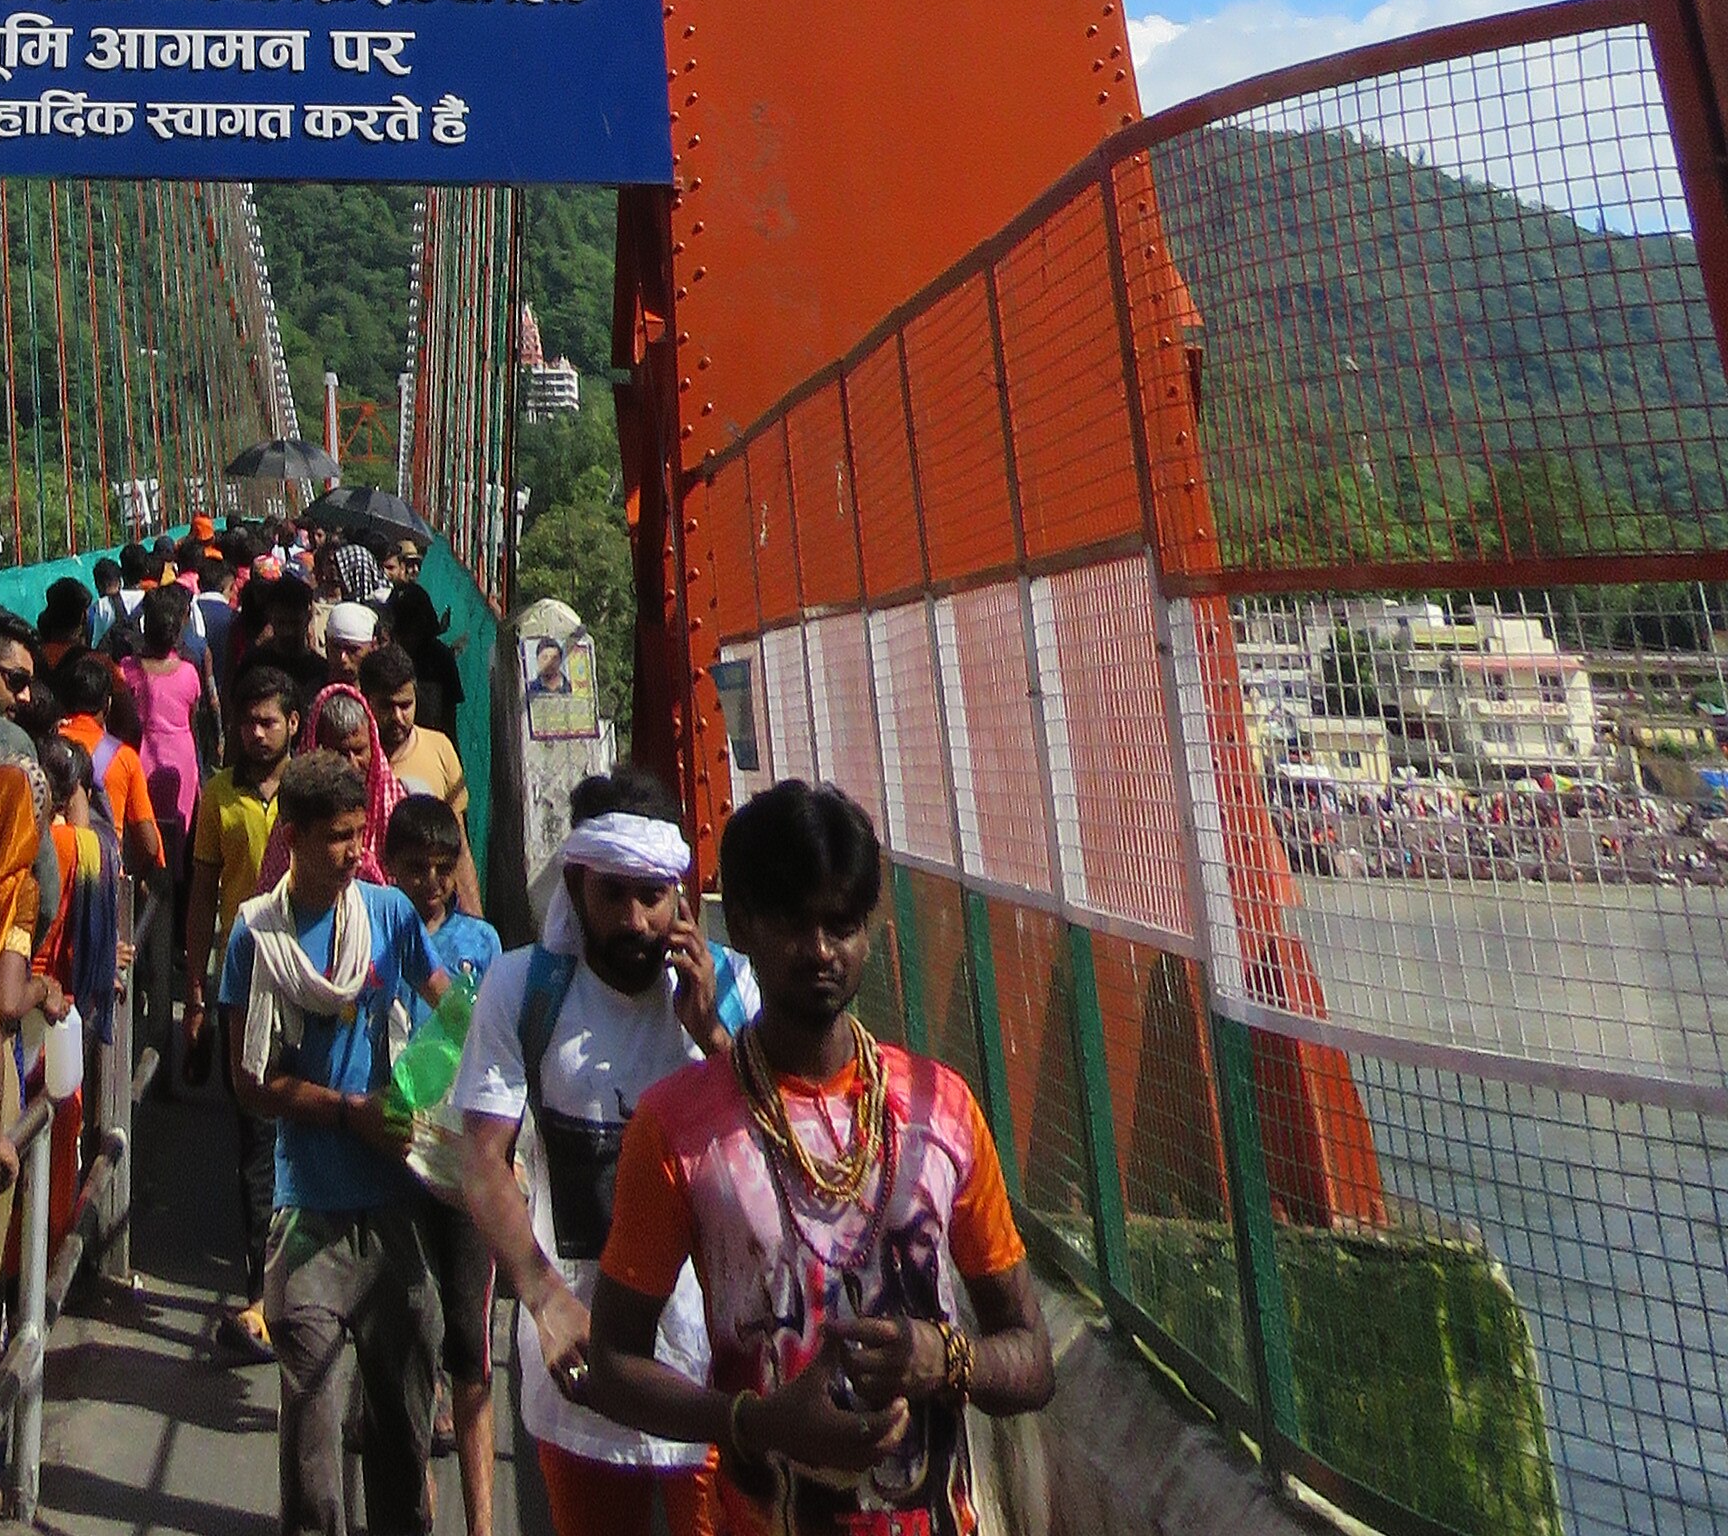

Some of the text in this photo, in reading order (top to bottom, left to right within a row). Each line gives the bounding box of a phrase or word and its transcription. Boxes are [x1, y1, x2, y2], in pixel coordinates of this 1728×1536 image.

[85, 28, 310, 71] आगमन
[330, 31, 416, 76] पर
[147, 101, 295, 140] स्वागत
[304, 95, 422, 143] करते
[432, 93, 470, 144] हैं
